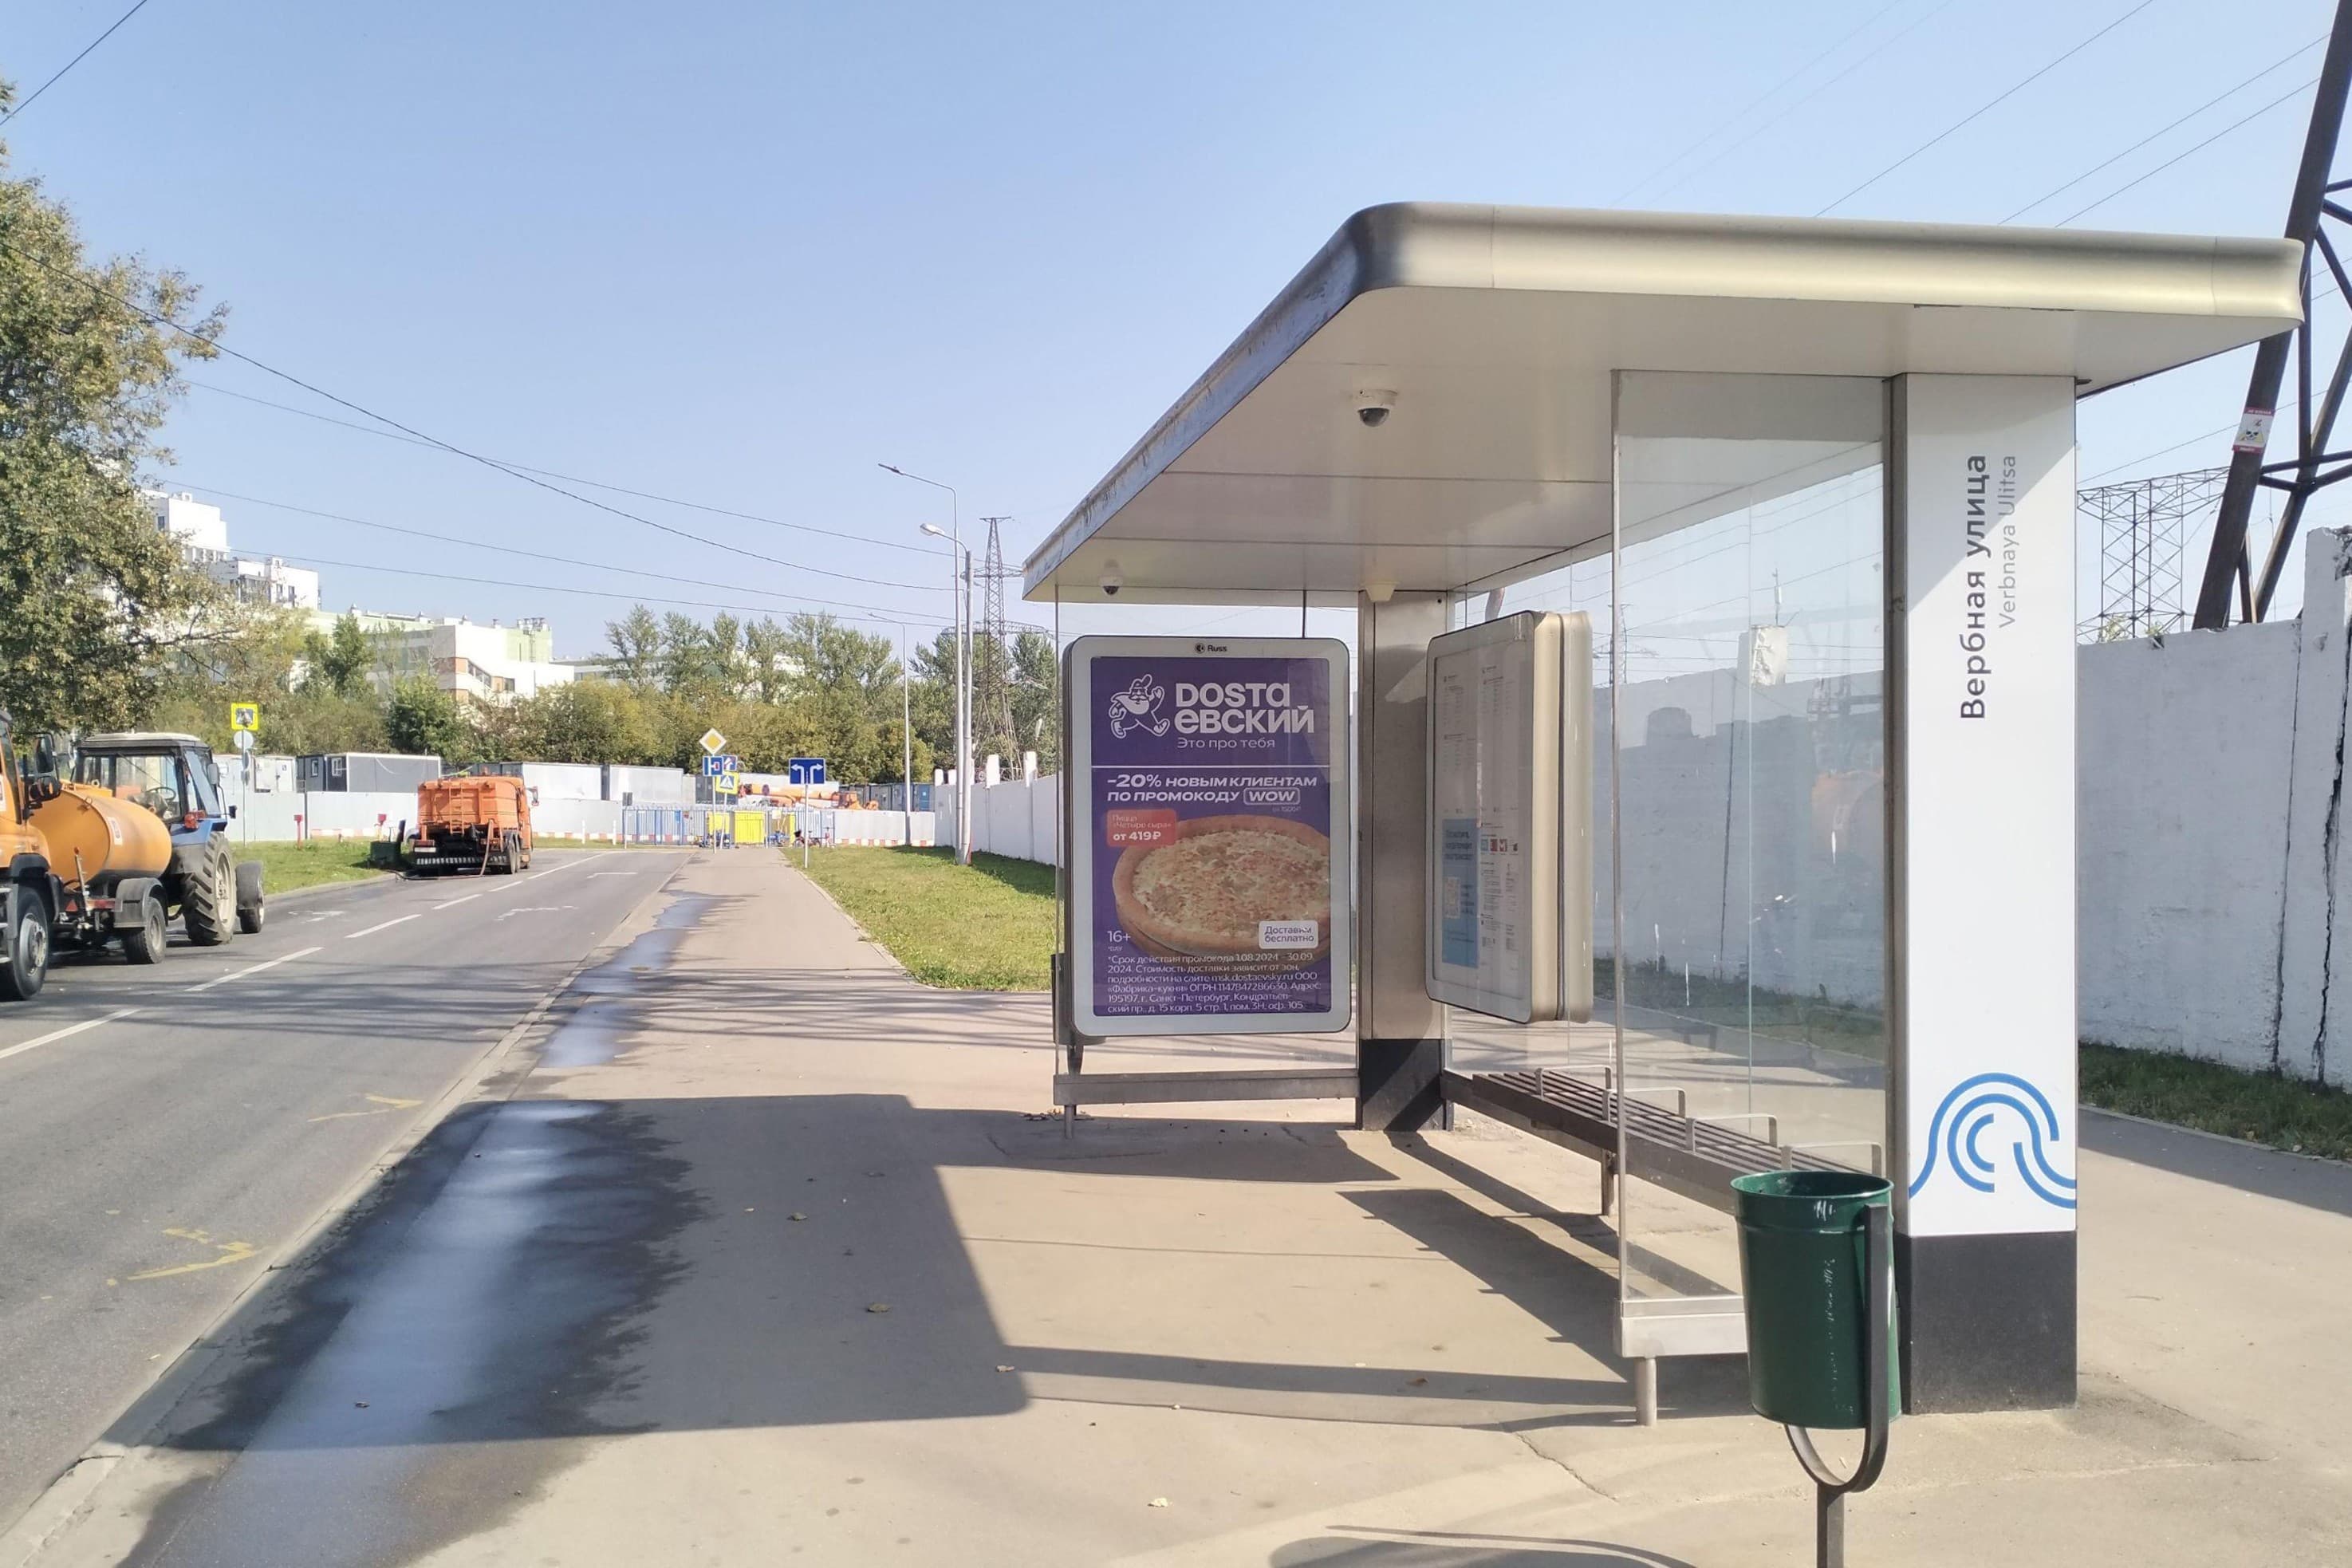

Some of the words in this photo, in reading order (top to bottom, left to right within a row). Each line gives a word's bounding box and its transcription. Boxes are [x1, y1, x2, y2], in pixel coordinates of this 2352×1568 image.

[1998, 455, 2016, 516] Ulitsa
[1967, 455, 1992, 558] улица
[1998, 525, 2019, 628] Verbnaya
[1959, 572, 1992, 719] Вербная
[1177, 737, 1205, 749] Это
[1208, 739, 1238, 751] про
[1239, 737, 1275, 749] тебя
[1165, 777, 1227, 787] НОВЫМ
[1229, 777, 1318, 786] КЛИЕНТАМ
[1107, 791, 1131, 802] ПО
[1133, 790, 1240, 803] ПРОМОКОДУ
[1249, 791, 1295, 802] WOW
[1107, 930, 1131, 943] 16+
[1264, 934, 1314, 944] бесплатно
[1135, 964, 1186, 973] Стоимость
[1188, 965, 1230, 974] доставки
[1231, 963, 1267, 972] зависит
[1107, 975, 1169, 985] подробности
[1184, 974, 1210, 983] сайте
[1294, 971, 1318, 980] ООО
[1189, 983, 1216, 991] ОГРН
[1159, 1003, 1168, 1012] 15
[1196, 1003, 1203, 1011] 5
